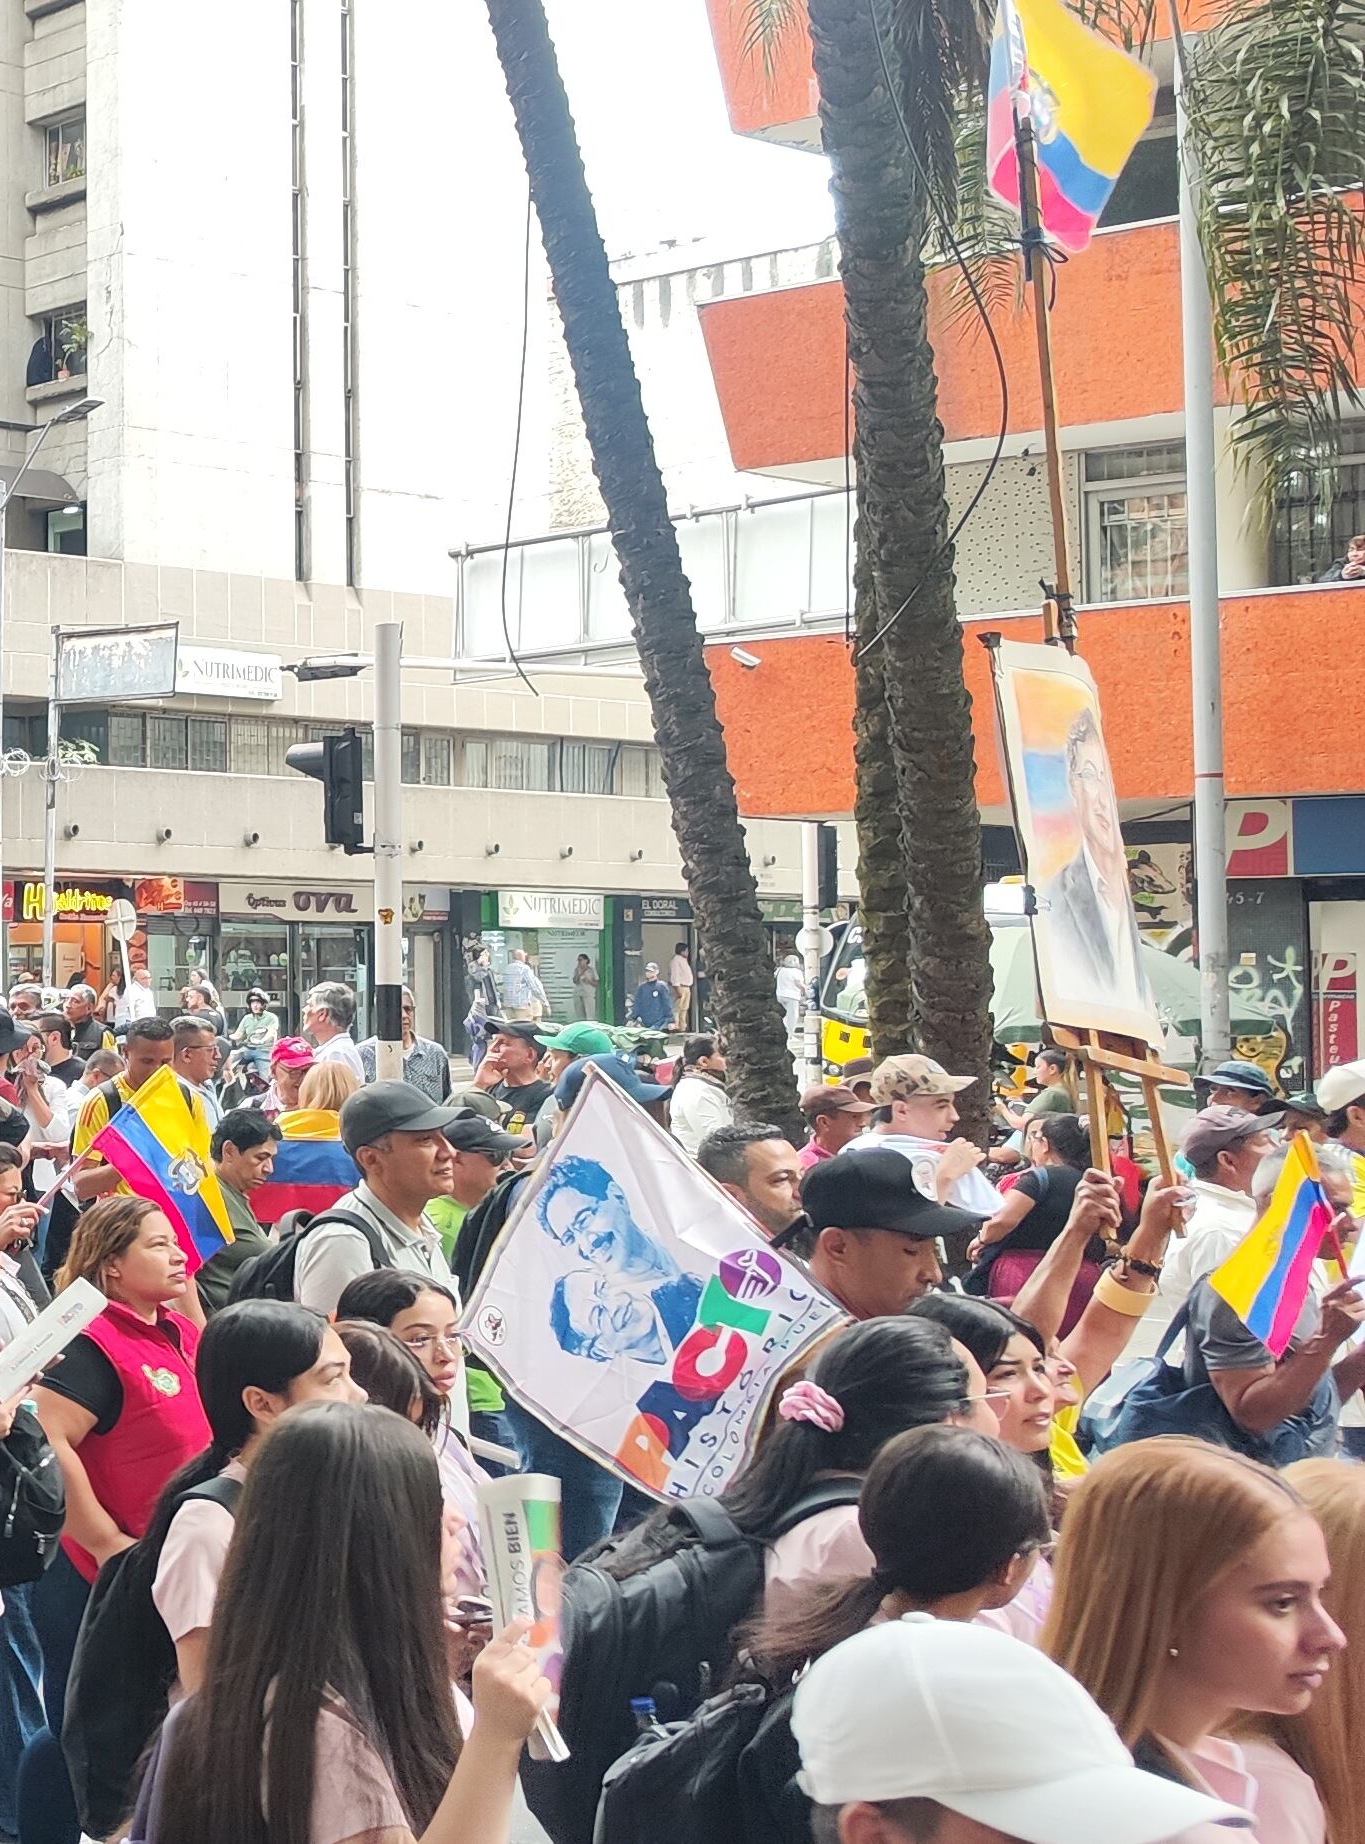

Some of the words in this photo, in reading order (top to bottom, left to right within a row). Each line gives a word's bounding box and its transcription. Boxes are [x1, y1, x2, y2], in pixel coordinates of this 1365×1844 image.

[193, 659, 278, 683] NUTRIMEDIC
[523, 895, 601, 915] NUTRIMEDIC
[642, 900, 651, 910] EL
[503, 1512, 521, 1554] BIEN
